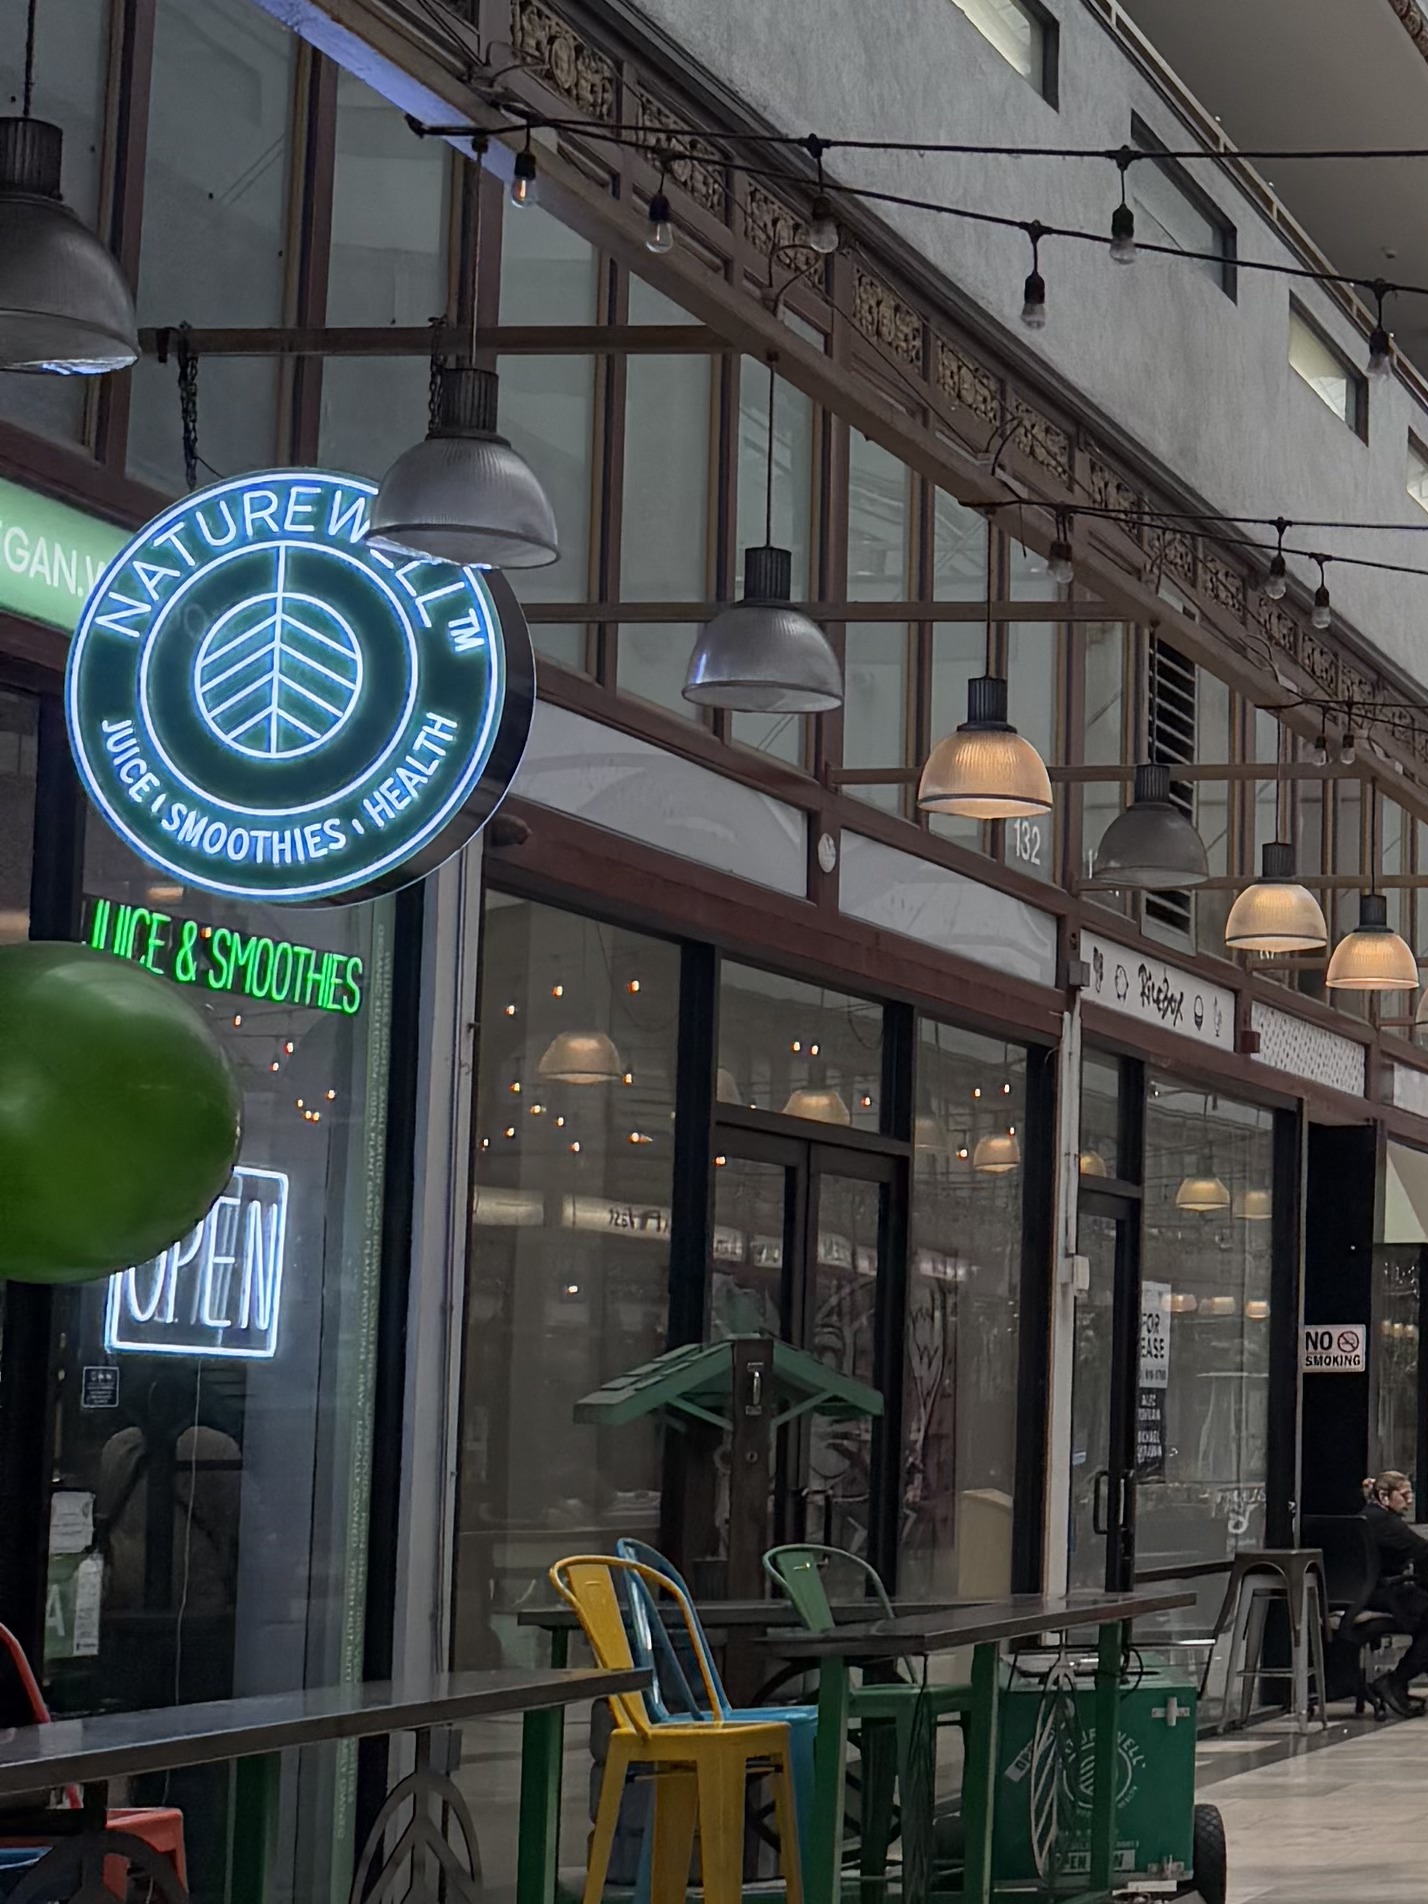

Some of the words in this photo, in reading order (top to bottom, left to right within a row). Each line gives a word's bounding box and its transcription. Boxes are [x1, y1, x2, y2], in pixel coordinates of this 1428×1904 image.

[95, 487, 465, 638] NATUREWLL
[102, 719, 160, 803] JUICE
[160, 802, 347, 865] SMOOTHIES
[362, 711, 458, 829] HEALTH
[1014, 818, 1041, 866] 132
[176, 920, 198, 982] &
[208, 927, 363, 1014] SMOOTHIES
[1138, 1337, 1165, 1359] EASE
[1305, 1331, 1333, 1352] NO
[1305, 1354, 1361, 1367] SMOKING
